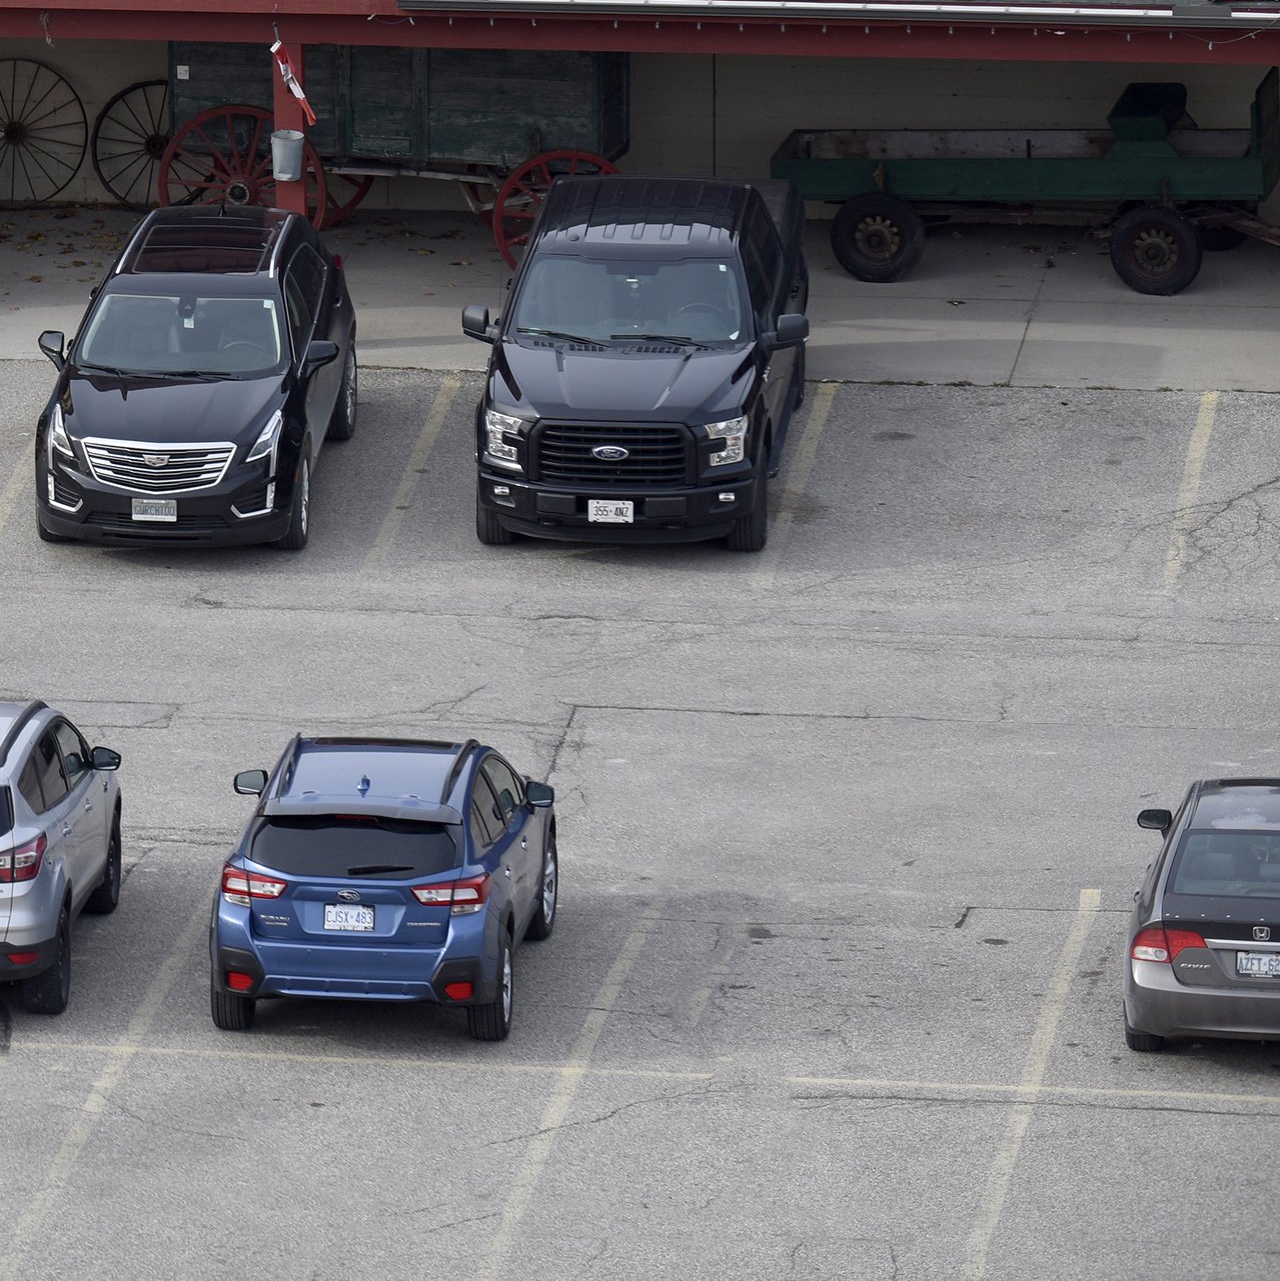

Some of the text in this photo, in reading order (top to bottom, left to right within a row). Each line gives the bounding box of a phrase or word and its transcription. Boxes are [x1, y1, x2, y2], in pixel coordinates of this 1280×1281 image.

[593, 506, 629, 517] 355 4NZ
[327, 910, 372, 924] CJSX 483
[1240, 957, 1262, 972] AZFT
